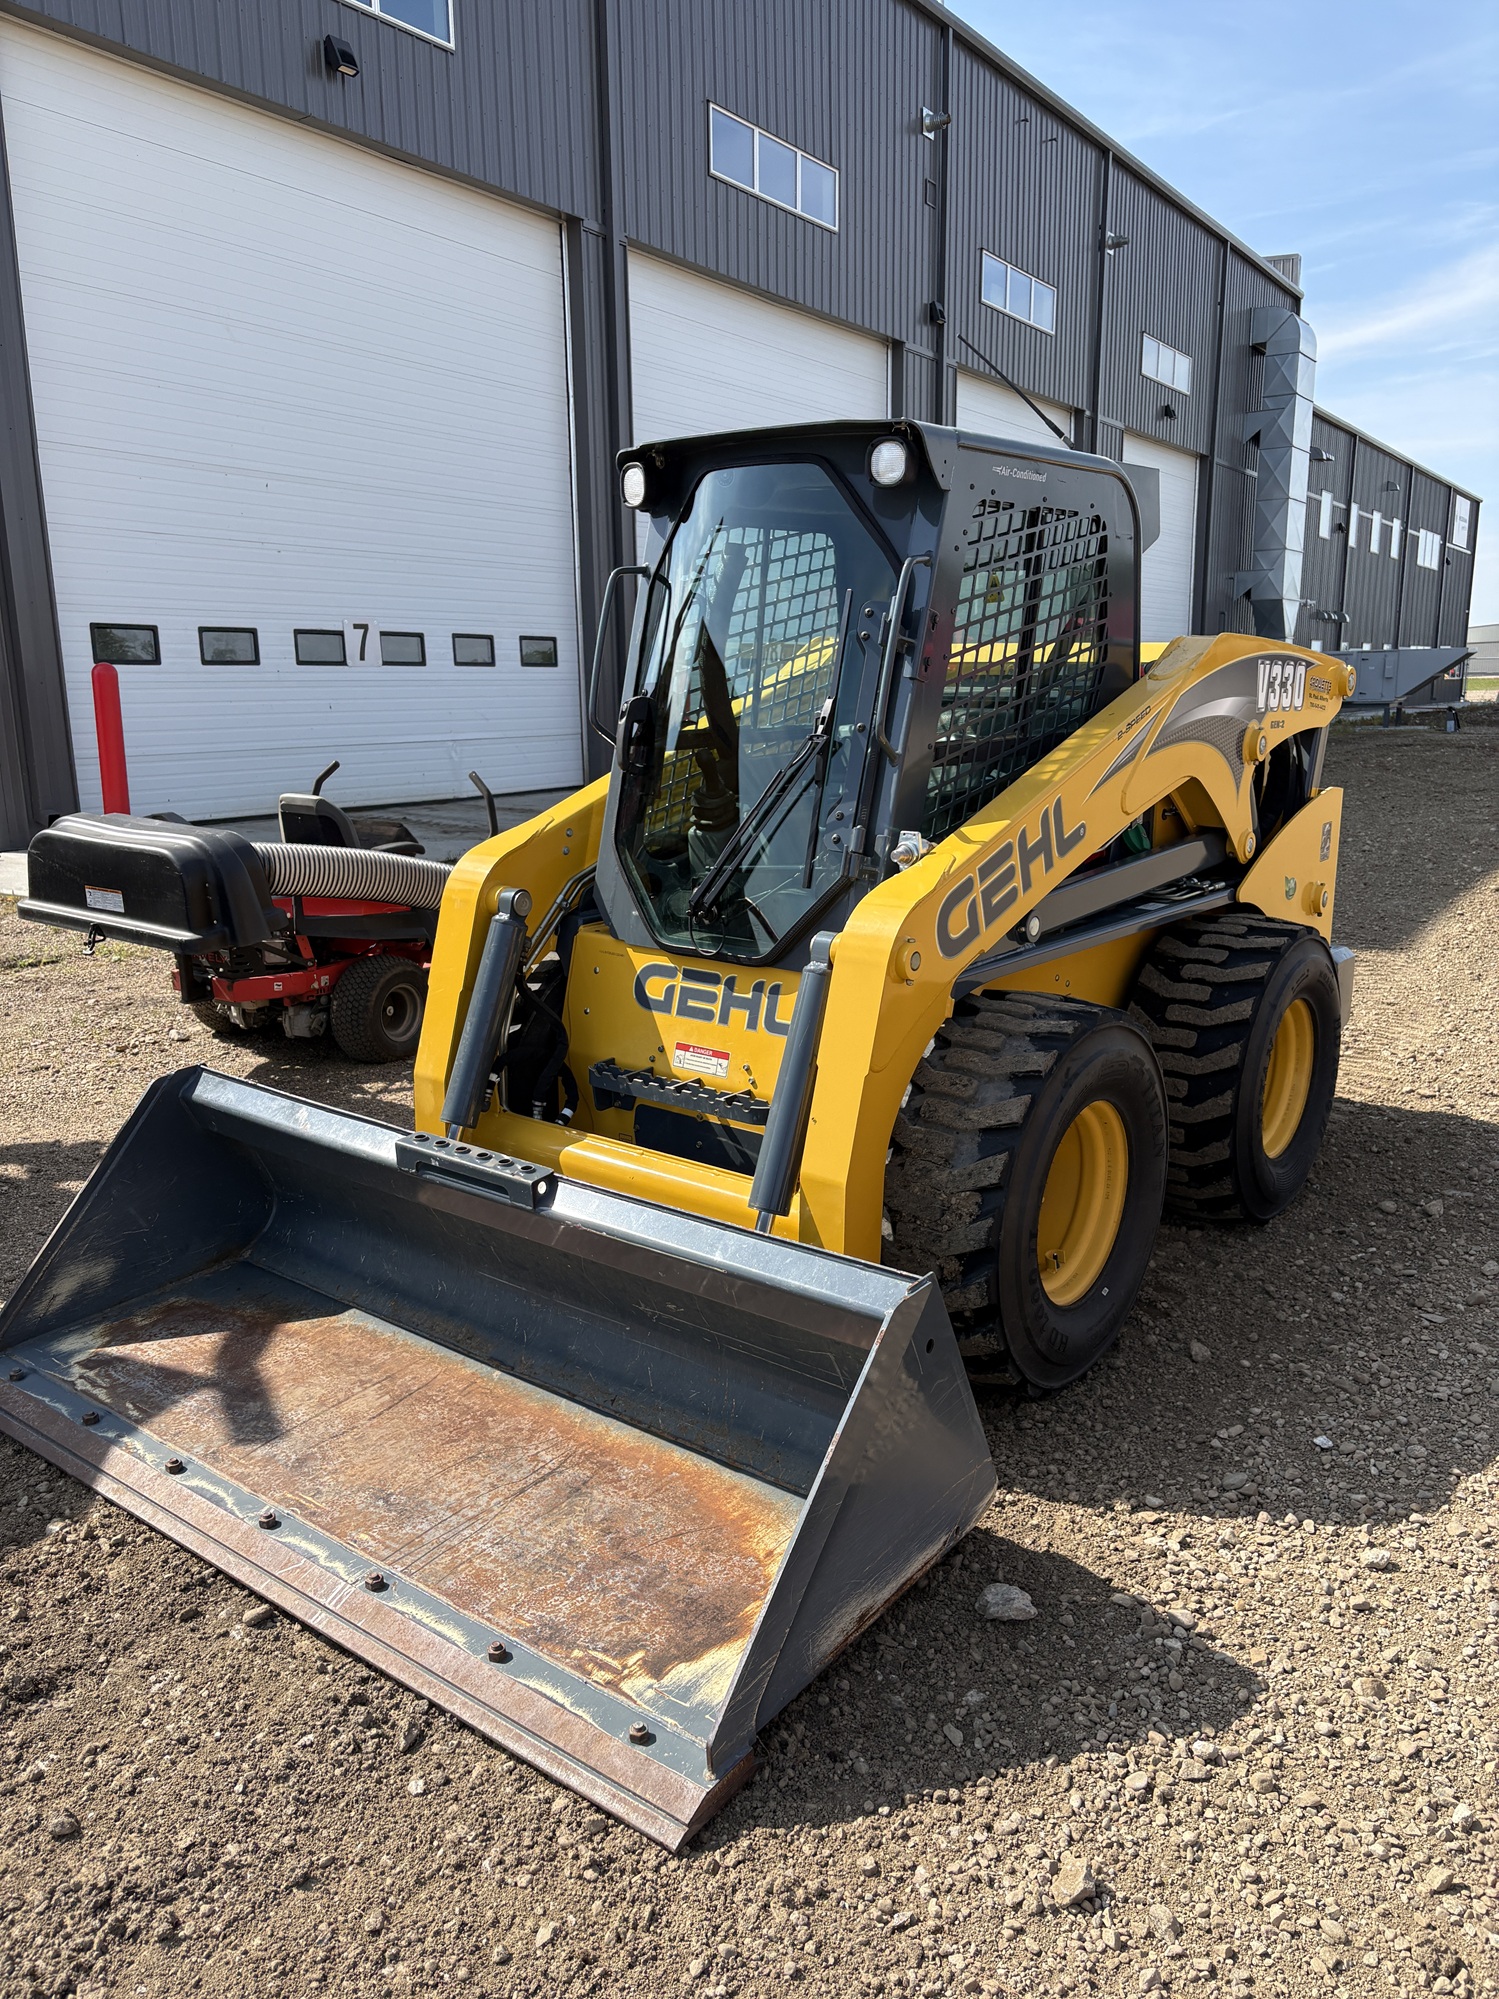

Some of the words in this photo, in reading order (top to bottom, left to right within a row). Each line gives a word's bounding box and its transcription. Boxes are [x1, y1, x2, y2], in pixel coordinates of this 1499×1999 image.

[1001, 465, 1047, 482] Air-Conditioned
[352, 623, 369, 661] 7
[1256, 659, 1306, 713] V330
[1117, 705, 1151, 741] 2-SPEED
[935, 793, 1086, 961] GEHL
[634, 961, 792, 1037] GEHL
[693, 1047, 713, 1056] DANGER
